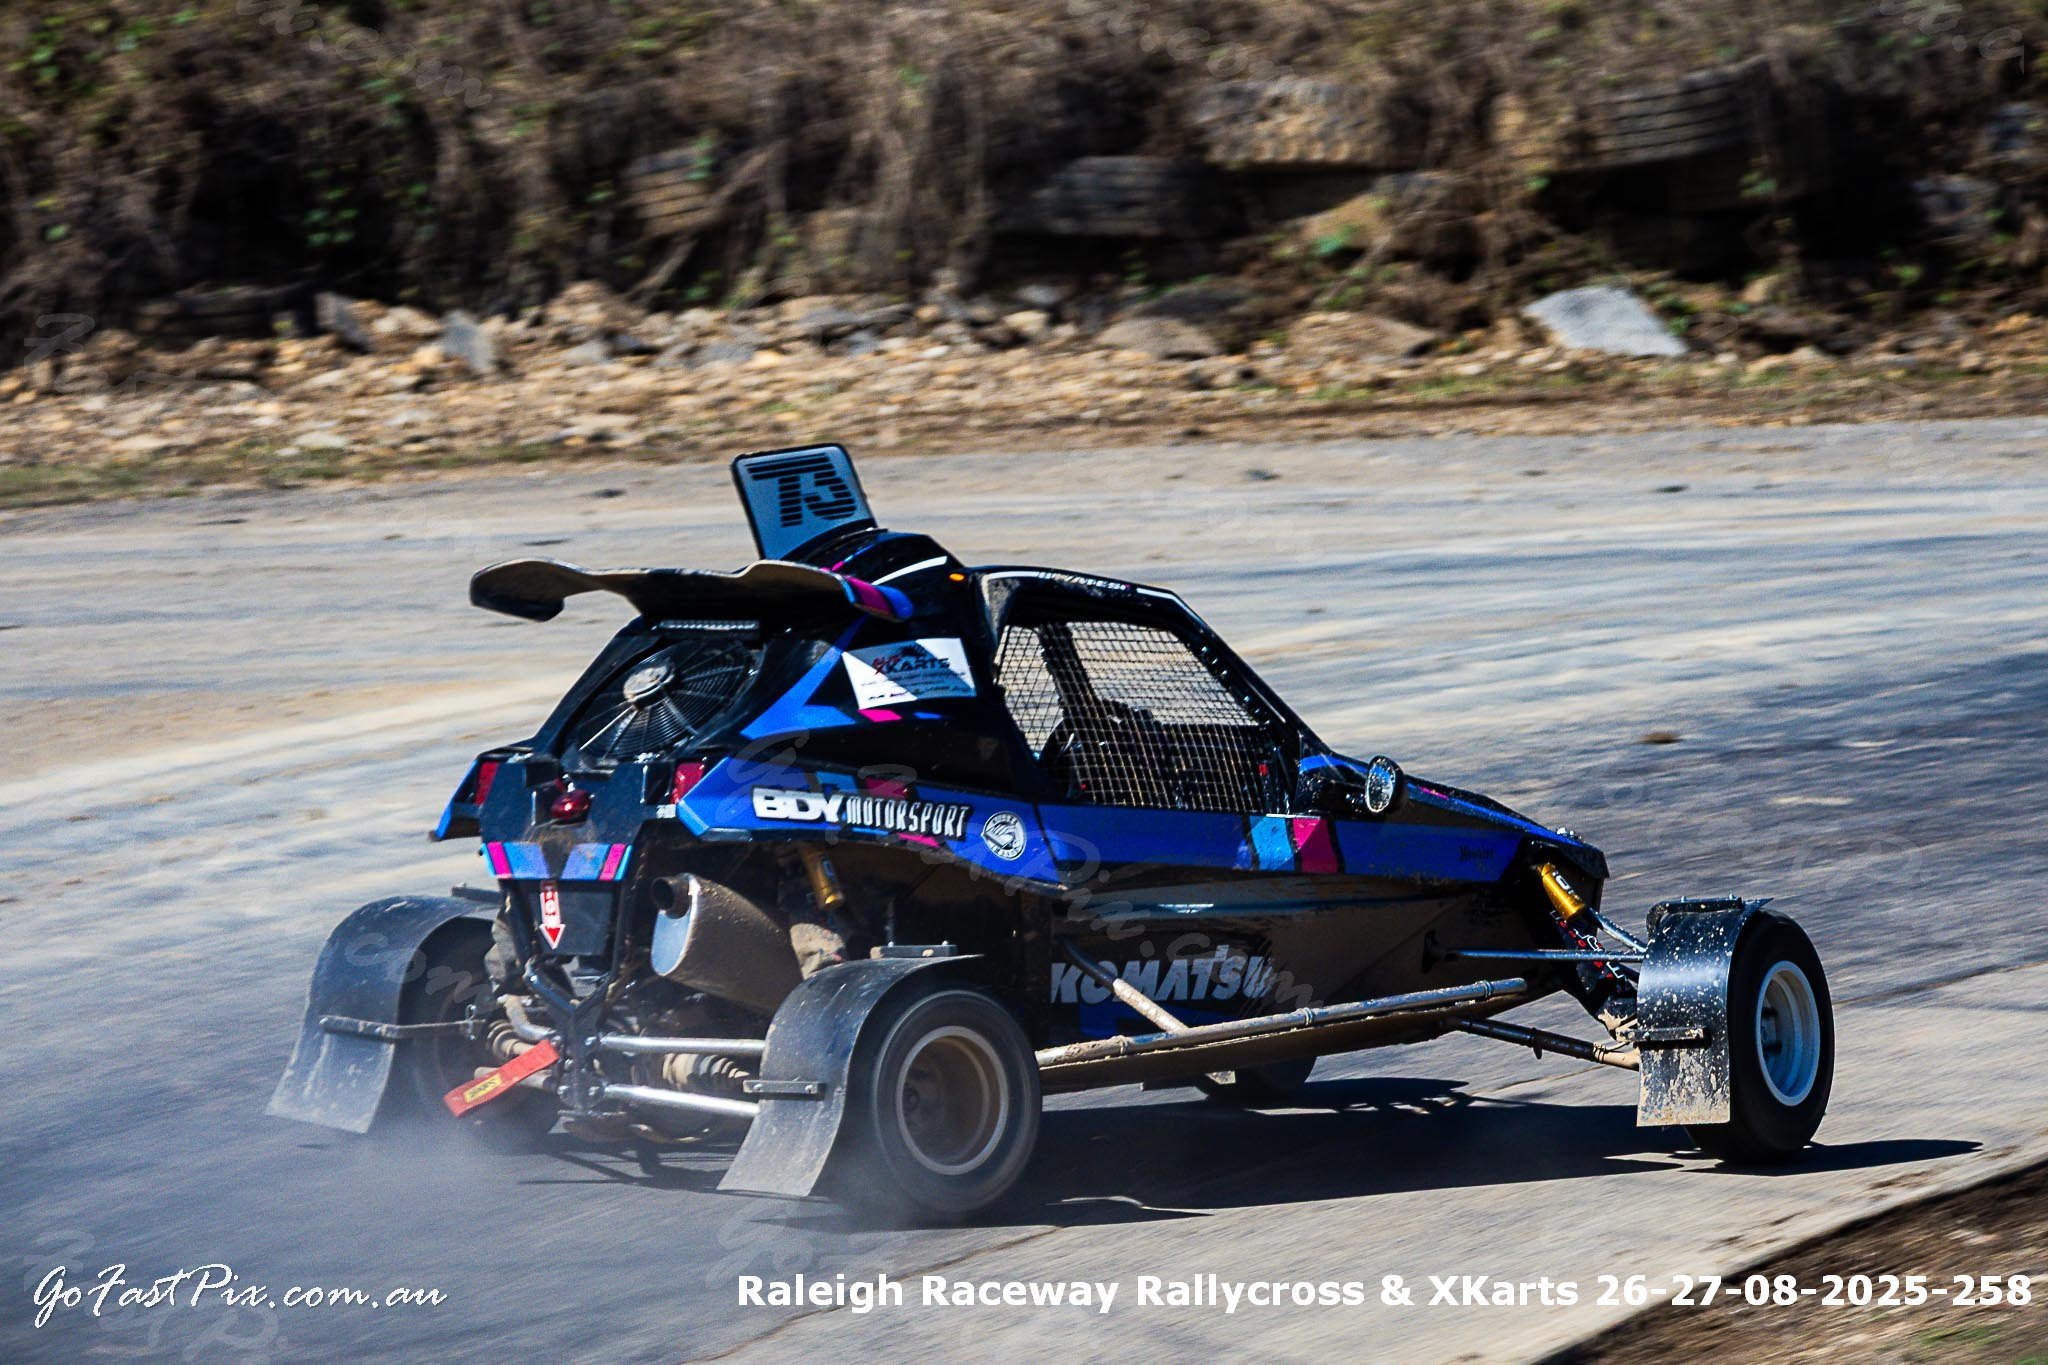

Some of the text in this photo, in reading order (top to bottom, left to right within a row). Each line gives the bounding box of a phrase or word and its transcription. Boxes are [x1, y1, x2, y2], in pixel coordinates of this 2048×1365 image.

[753, 787, 844, 822] BDY
[846, 796, 970, 837] MOTORSPORT
[1051, 945, 1277, 1004] KOMATSU
